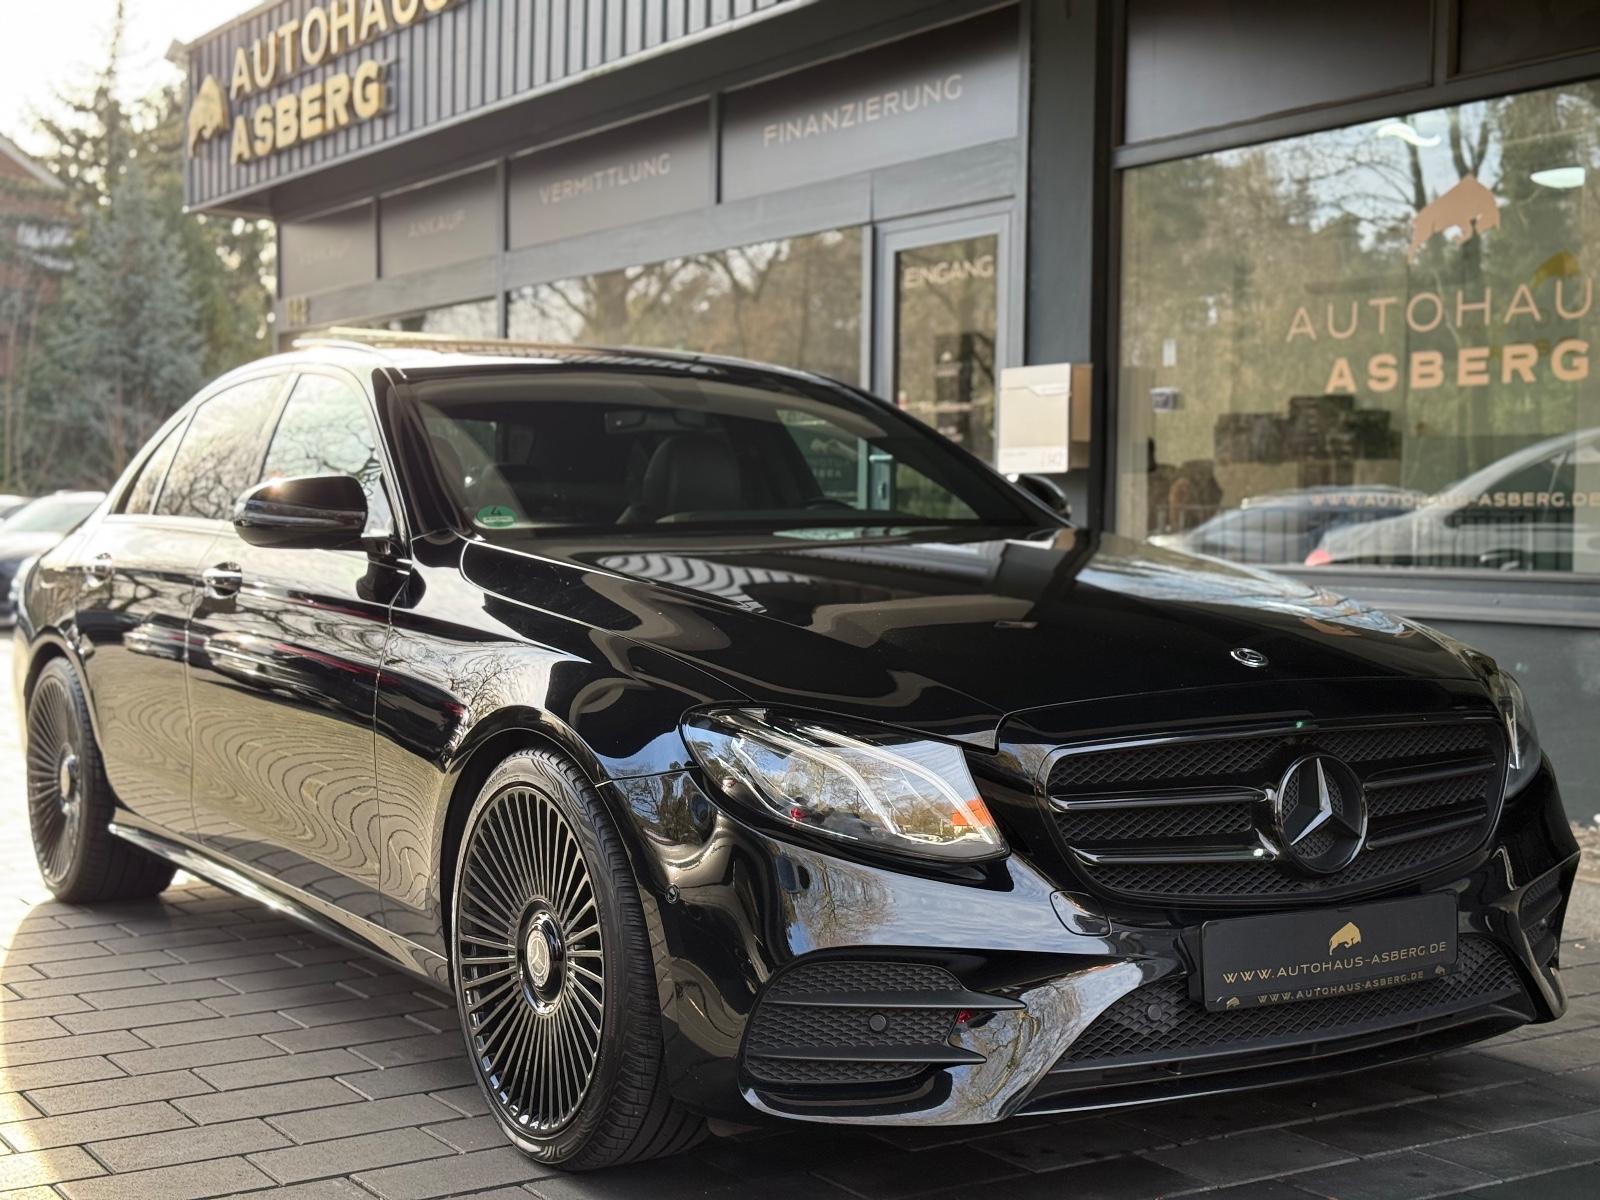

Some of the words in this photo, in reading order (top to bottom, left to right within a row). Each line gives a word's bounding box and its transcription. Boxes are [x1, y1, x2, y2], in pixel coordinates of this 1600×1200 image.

[229, 0, 448, 100] AUTOHAU
[230, 60, 381, 166] ASBERG
[762, 73, 964, 148] FINANZIERUNG
[539, 153, 671, 205] VERMITTLUNG
[1286, 277, 1593, 342] AUTOHAU
[1325, 339, 1590, 394] ASBERG
[1310, 491, 1600, 508] WWW.AUTO-ASBERG.DE
[1223, 941, 1447, 984] WWW.AUTOHAUS-ASBERG.DE
[1257, 970, 1425, 1004] WWW.AUTOHAUS-ASBERG.DE
